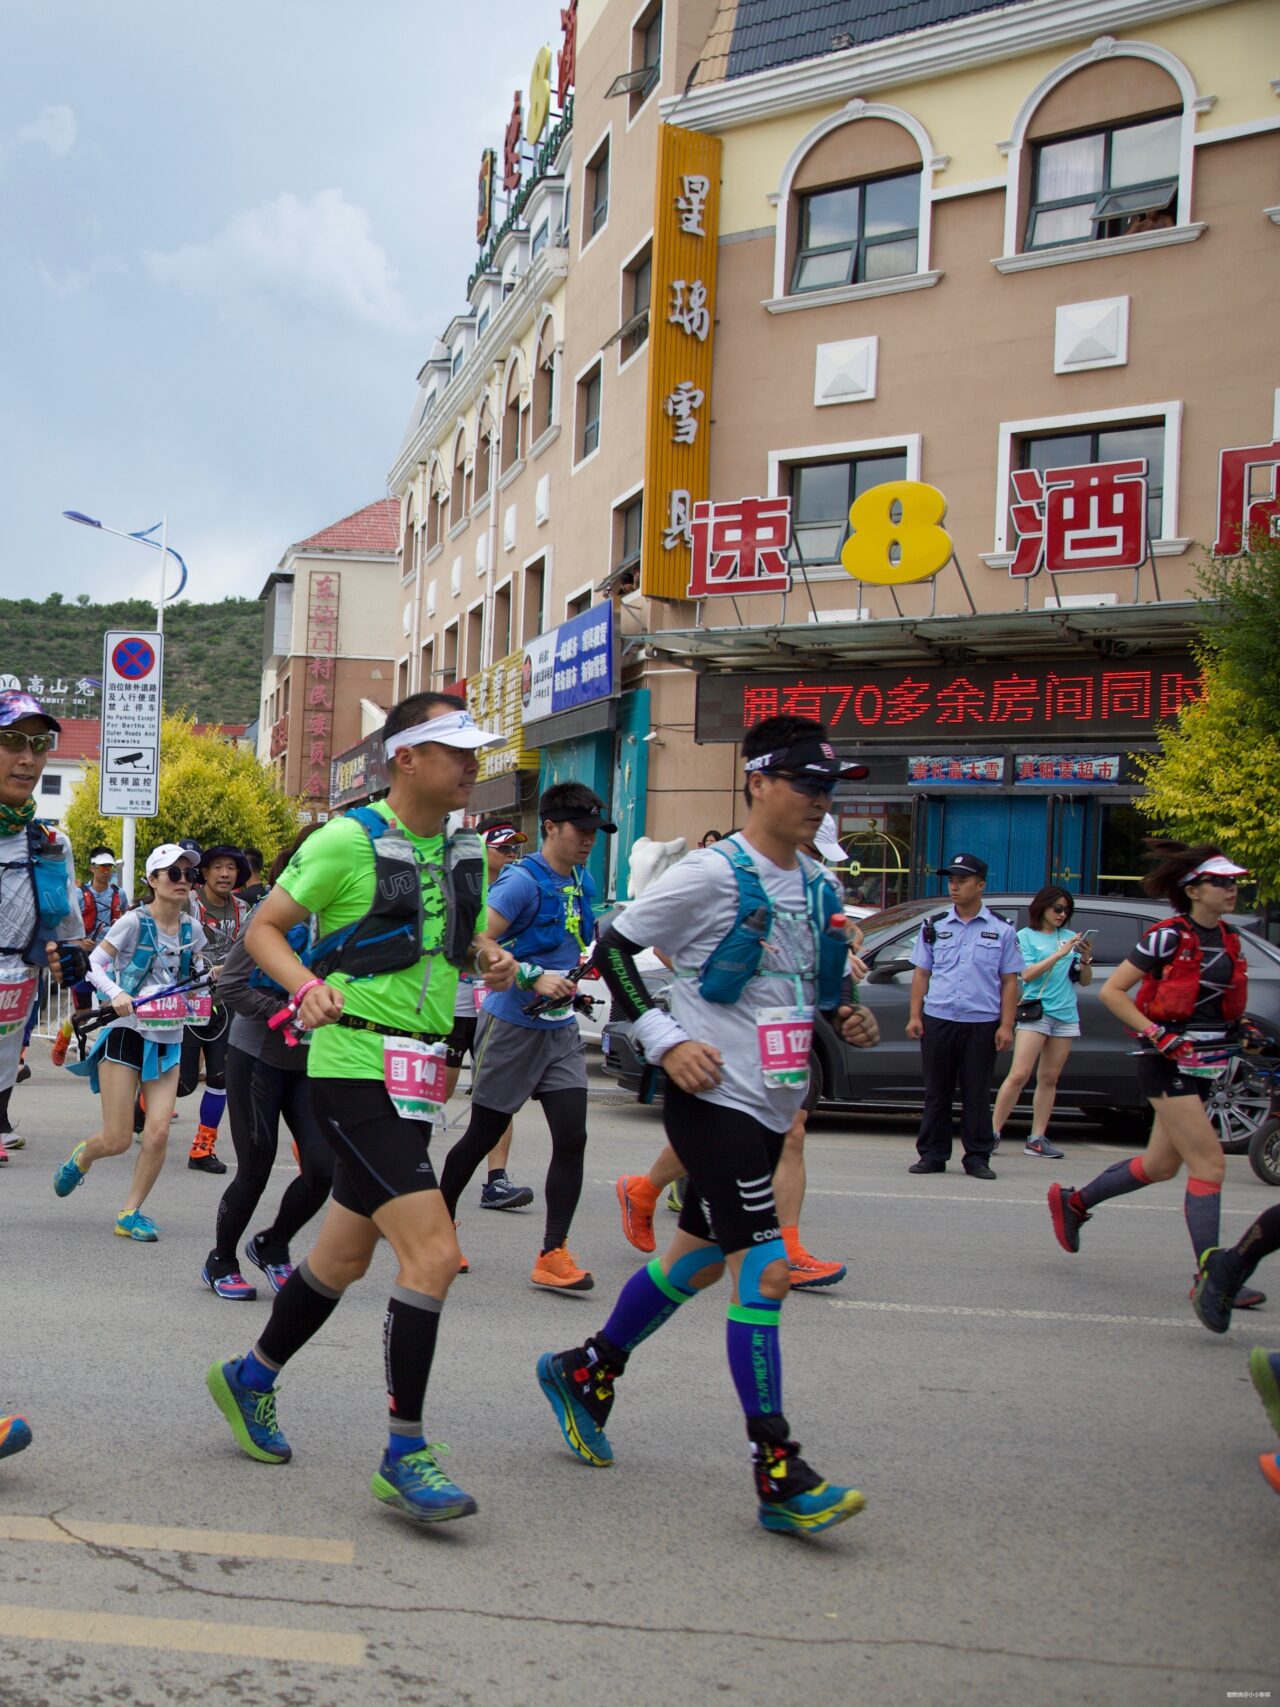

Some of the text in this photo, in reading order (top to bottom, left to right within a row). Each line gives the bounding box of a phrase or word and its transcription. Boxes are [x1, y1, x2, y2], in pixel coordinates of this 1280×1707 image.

[108, 683, 157, 692] 泊位除外道路
[108, 693, 156, 702] 及人行便道
[108, 703, 156, 712] 禁止停车
[912, 761, 1000, 780] 崇礼最大雪
[1020, 761, 1114, 780] 具租赁超市
[109, 777, 152, 787] 视频监控
[156, 997, 178, 1010] 1744
